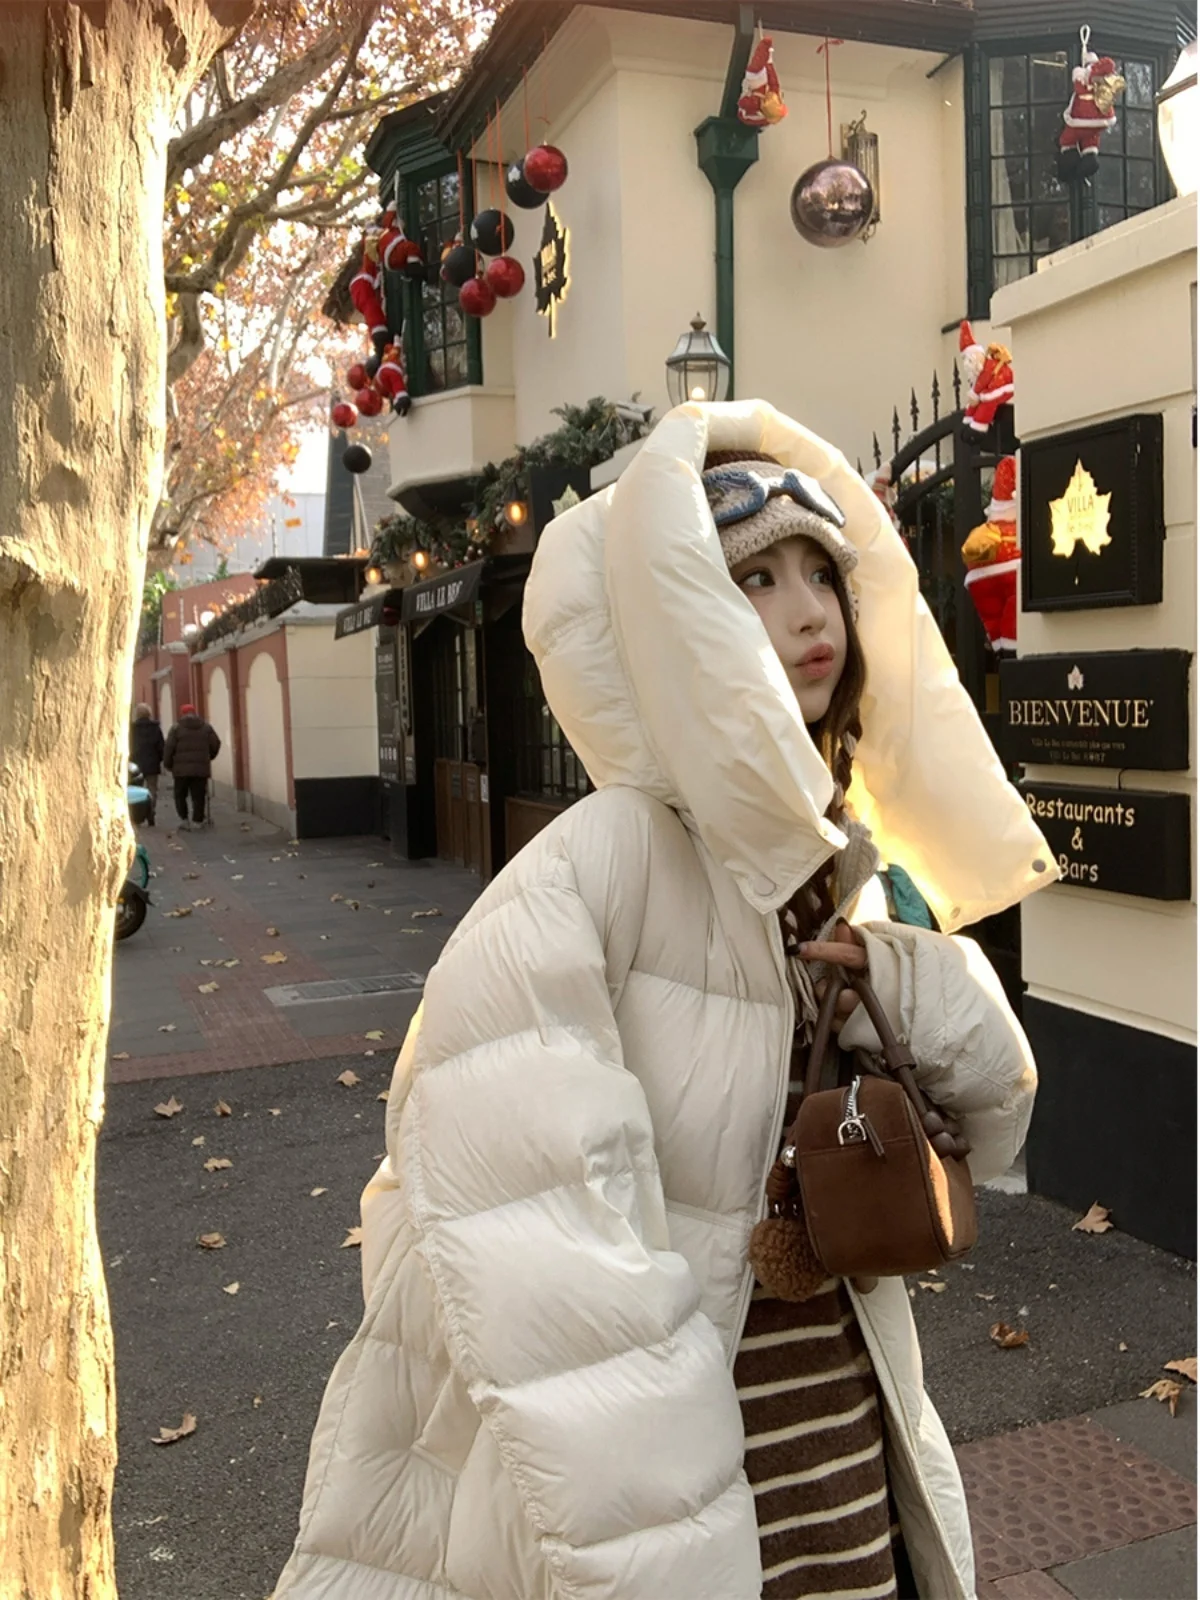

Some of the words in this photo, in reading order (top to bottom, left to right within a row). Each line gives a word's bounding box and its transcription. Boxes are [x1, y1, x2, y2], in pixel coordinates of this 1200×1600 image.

[1067, 494, 1095, 514] VILLA
[1025, 793, 1136, 827] Restaurants
[1071, 826, 1084, 852] &
[1059, 853, 1099, 883] Bars
